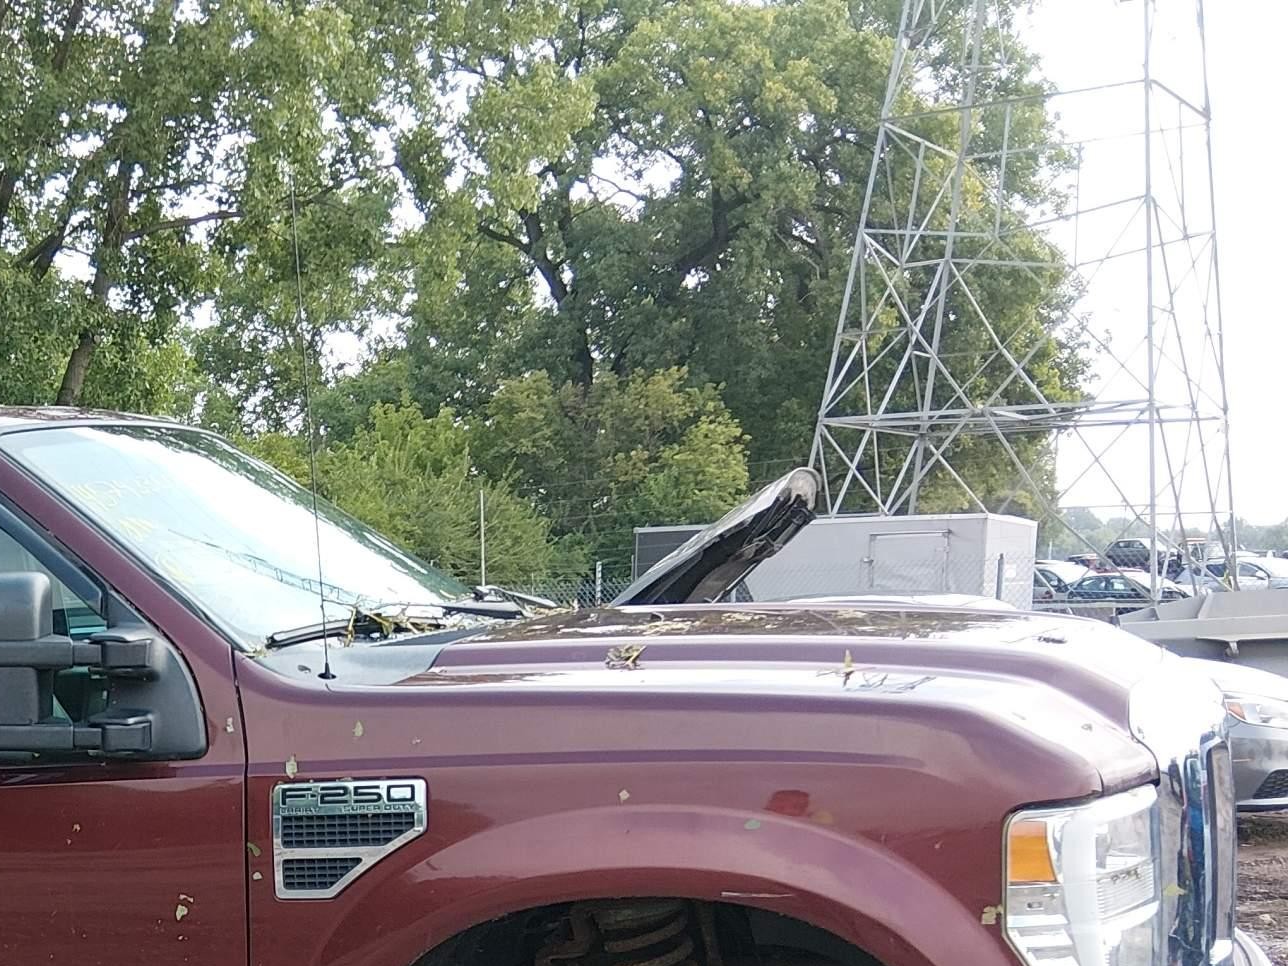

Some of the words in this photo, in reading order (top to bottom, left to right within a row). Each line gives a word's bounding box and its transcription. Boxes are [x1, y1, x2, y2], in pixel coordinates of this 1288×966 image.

[280, 784, 416, 806] F-250
[341, 805, 382, 813] SUPER
[383, 803, 416, 811] DUTY
